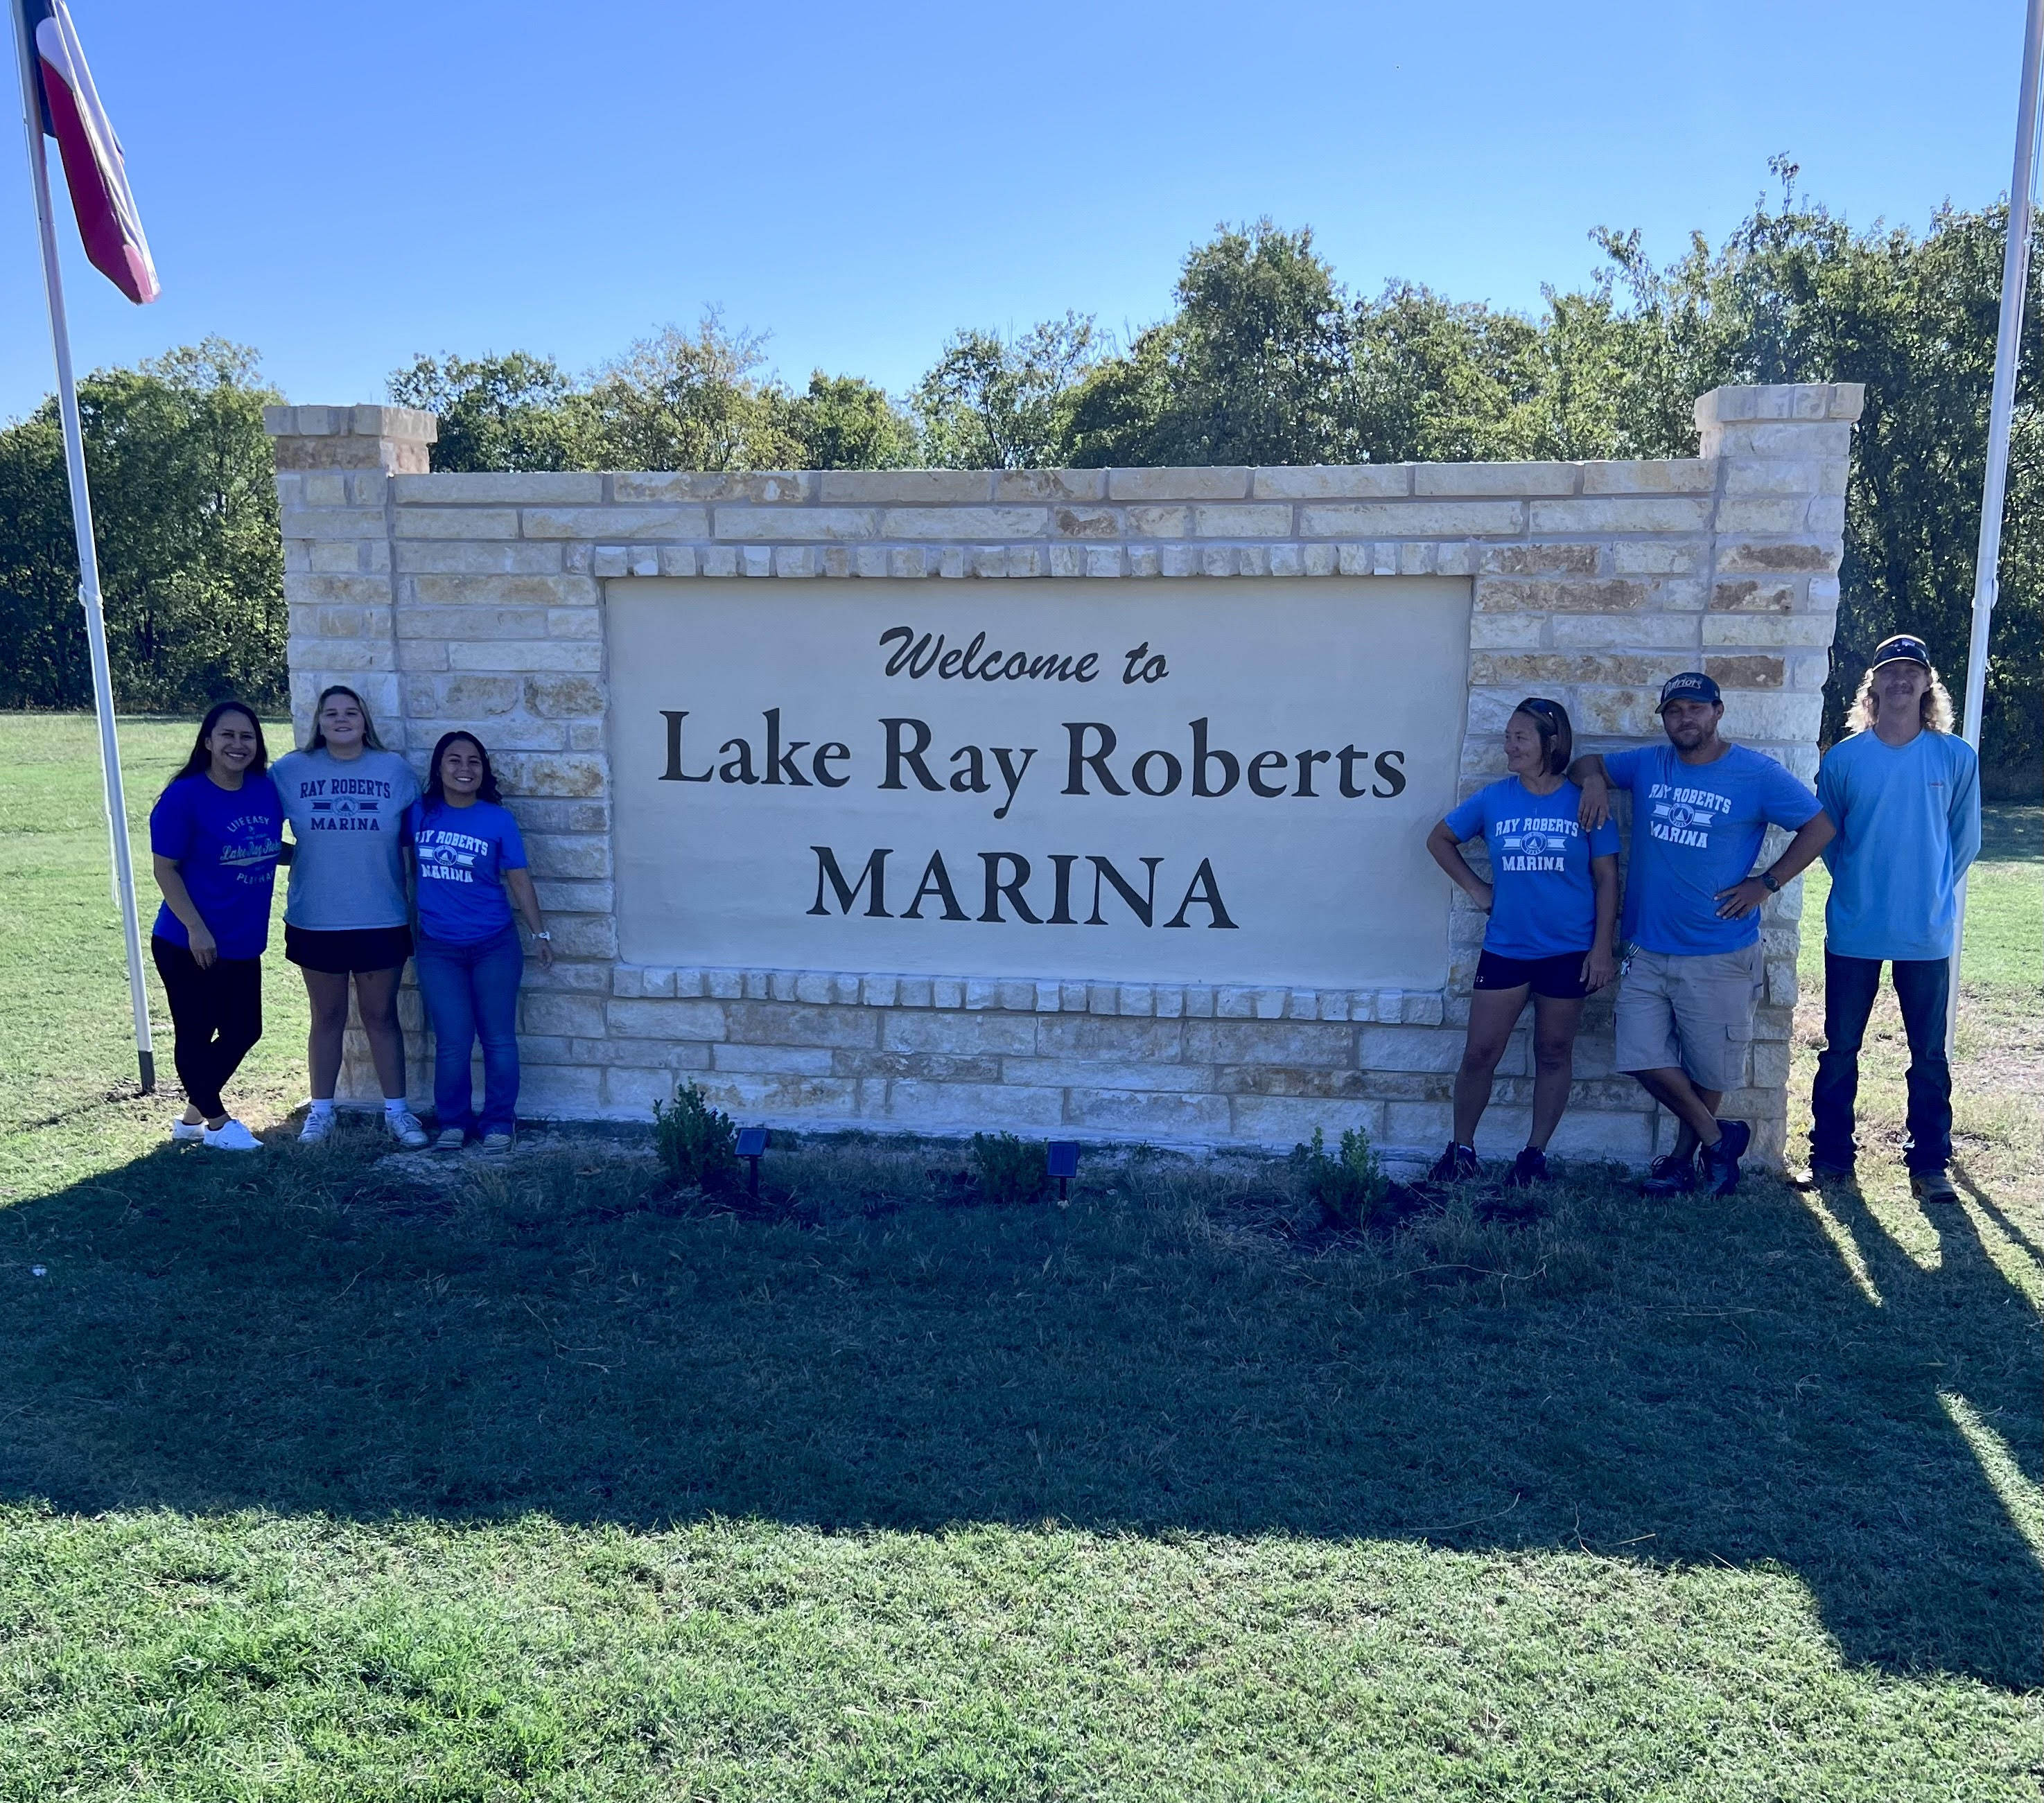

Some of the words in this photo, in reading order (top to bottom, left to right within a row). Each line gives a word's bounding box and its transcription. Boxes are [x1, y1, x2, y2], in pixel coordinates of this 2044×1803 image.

[878, 625, 1099, 683] Welcome
[1122, 641, 1170, 685] to
[658, 707, 850, 788] Lake
[877, 718, 1038, 820] Ray
[1060, 716, 1406, 799] Roberts
[300, 780, 326, 798] RAY
[331, 779, 390, 798] ROBERTS
[1648, 784, 1672, 798] RAY
[1672, 787, 1731, 813] ROBERTS
[245, 816, 269, 825] EASY
[311, 817, 380, 831] MARINA
[1495, 818, 1521, 837] RAY
[1523, 818, 1579, 837] ROBERTS
[435, 831, 489, 856] ROBERTS
[1650, 821, 1708, 848] MARINA
[421, 864, 473, 883] MARINA
[1502, 856, 1564, 872] MARINA
[805, 845, 1240, 929] MARINA
